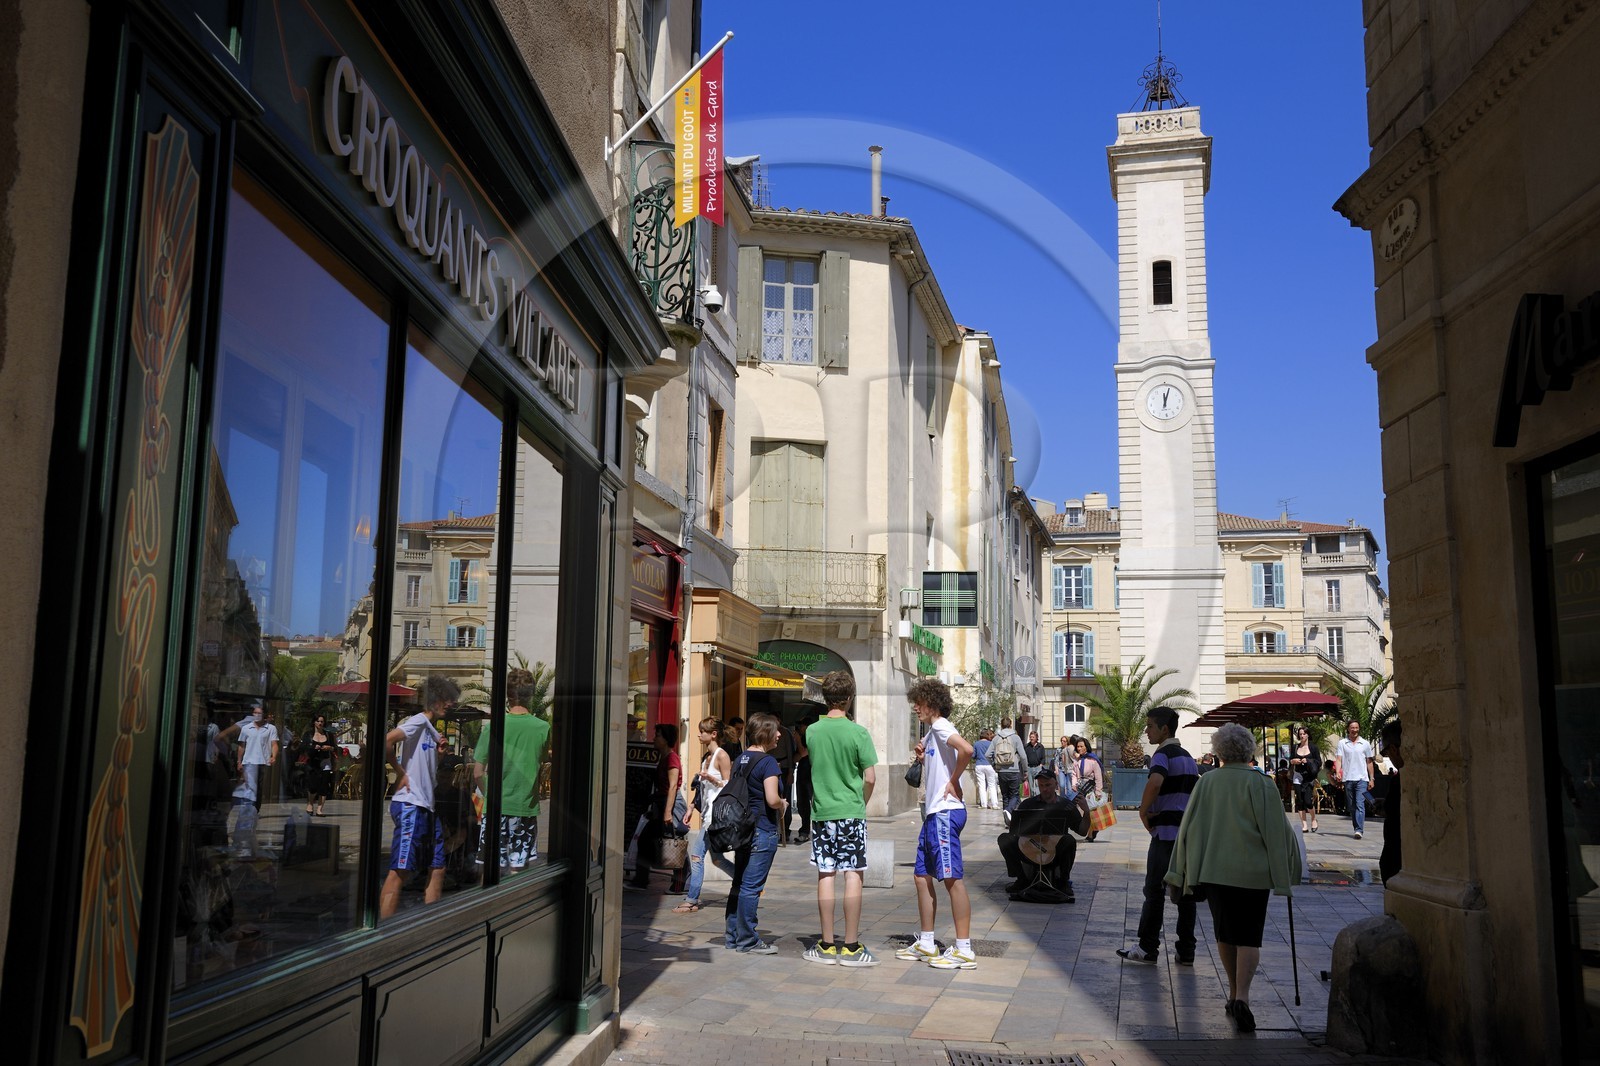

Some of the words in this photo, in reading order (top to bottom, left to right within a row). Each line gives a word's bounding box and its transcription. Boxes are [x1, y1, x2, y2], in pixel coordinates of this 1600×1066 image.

[707, 80, 719, 118] Gard
[682, 109, 694, 141] GOÛT
[707, 122, 717, 142] du
[683, 144, 694, 159] DU
[683, 162, 694, 213] MILITANT
[705, 147, 717, 212] Produits
[1388, 203, 1404, 229] RUE
[324, 55, 500, 321] CROQUANTS
[506, 277, 584, 415] VILLARET
[780, 652, 828, 662] PHARMACIE
[627, 748, 659, 761] OLAS
